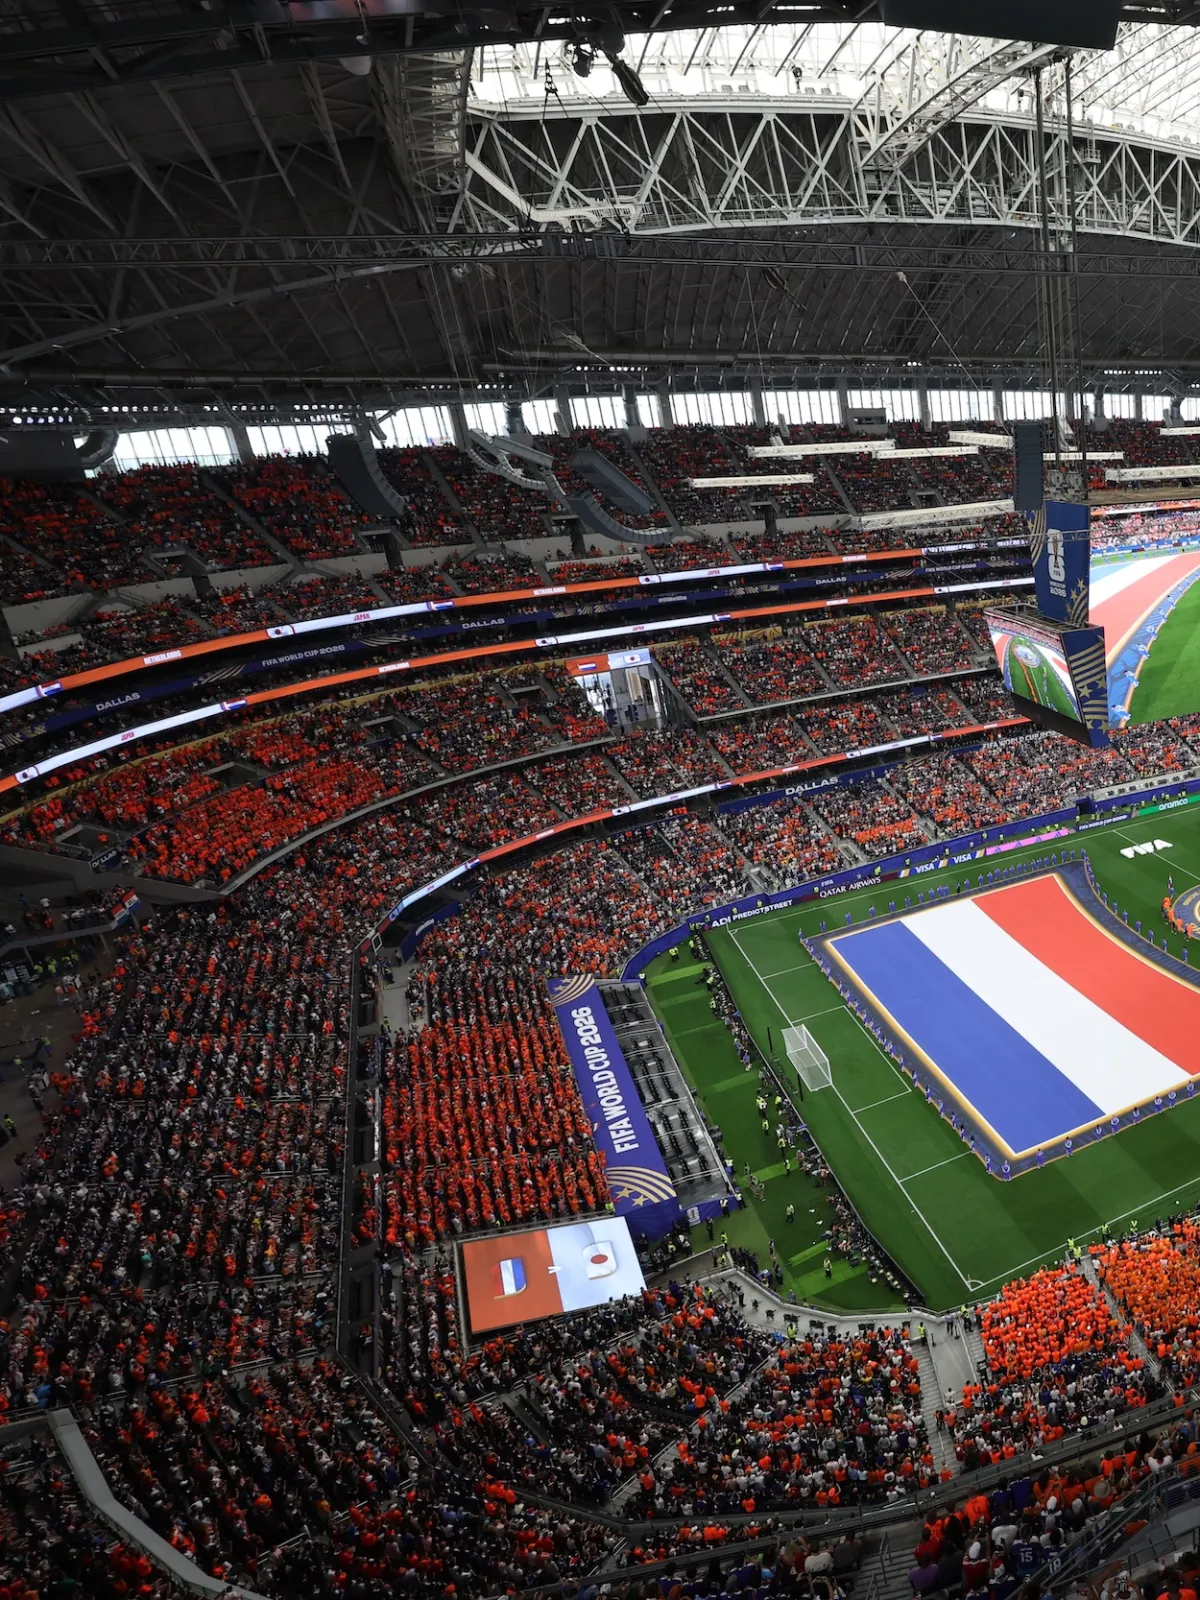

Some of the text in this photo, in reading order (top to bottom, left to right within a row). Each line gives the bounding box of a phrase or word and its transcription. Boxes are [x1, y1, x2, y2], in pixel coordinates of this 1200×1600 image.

[815, 575, 848, 586] DALLAS
[353, 612, 371, 622] JAPAN
[461, 617, 506, 630] DALLAS
[261, 643, 346, 668] FIFA WORLD CUP 2026
[96, 692, 141, 712] DALLAS
[785, 776, 839, 796] DALLAS
[1158, 798, 1189, 811] aramco
[1120, 838, 1174, 859] FIFA
[952, 853, 973, 865] VISA
[914, 862, 935, 874] VISA
[819, 876, 882, 899] QATAR AIRWAYS
[821, 879, 834, 888] FIFA
[712, 899, 793, 928] ADI PREDICTSTREET
[571, 1005, 640, 1154] FIFA WORLD CUP 2026
[1019, 1551, 1033, 1563] 15
